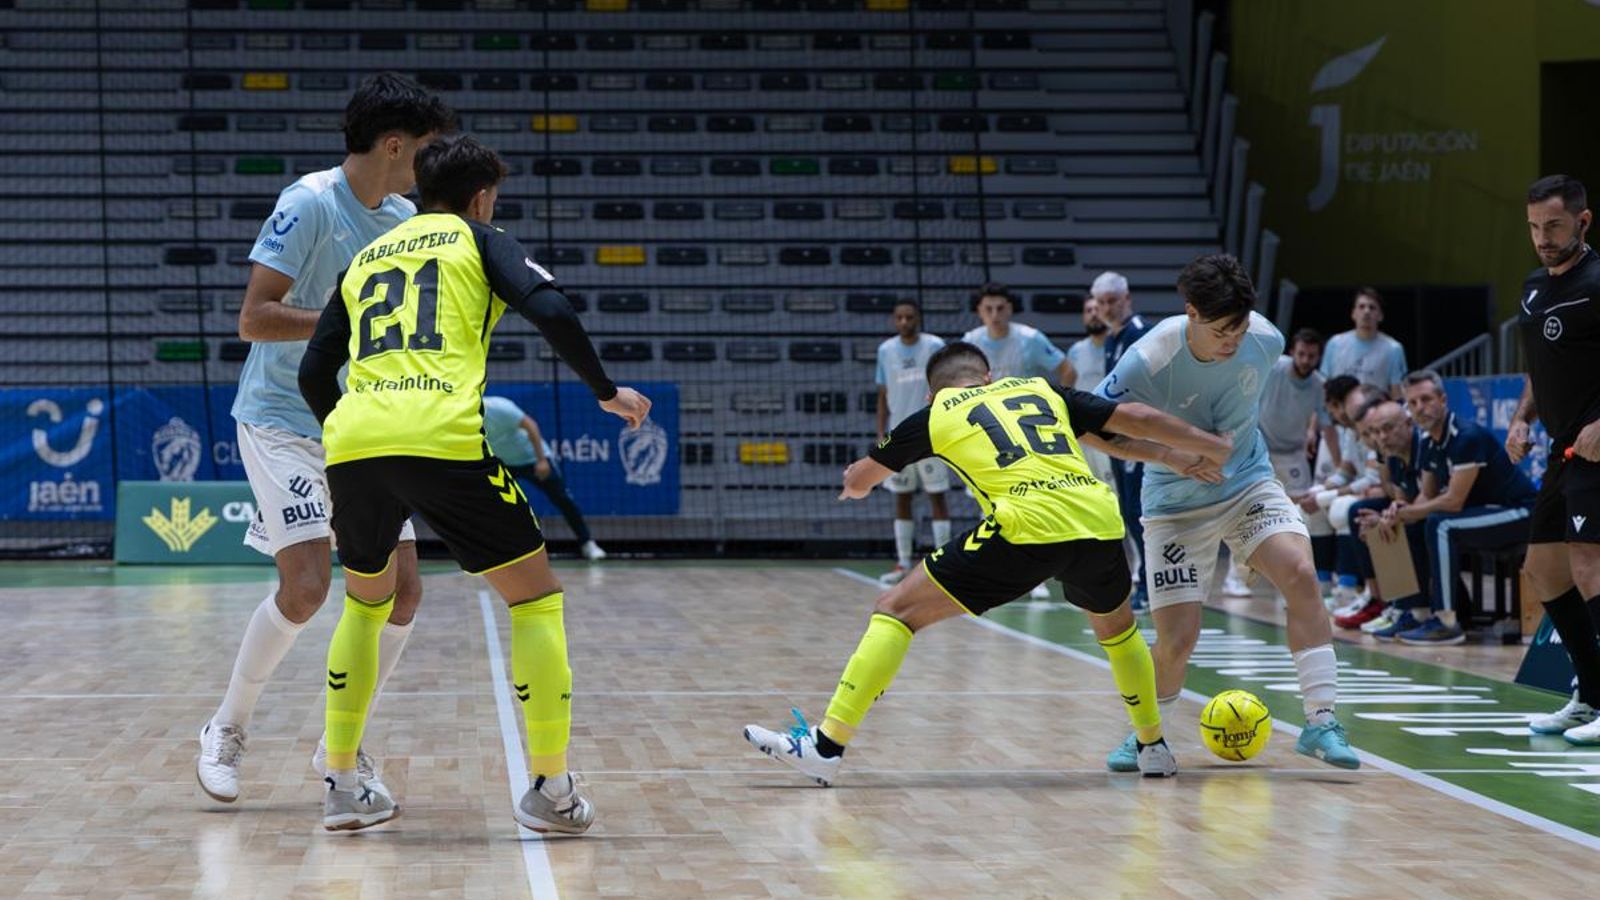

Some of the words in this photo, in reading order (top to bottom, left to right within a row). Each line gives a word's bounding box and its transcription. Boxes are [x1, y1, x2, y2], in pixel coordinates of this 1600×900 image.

[1346, 130, 1478, 152] DIPUTACIÓN
[1346, 163, 1373, 180] DE
[1379, 160, 1430, 180] JAÉN
[358, 240, 405, 267] PABLO
[407, 231, 459, 252] OTERO
[357, 257, 447, 362] 21
[372, 375, 454, 393] trainline
[967, 394, 1074, 469] 12
[28, 472, 100, 512] jaén
[1031, 472, 1098, 490] trainline
[1154, 563, 1198, 588] BULÉ
